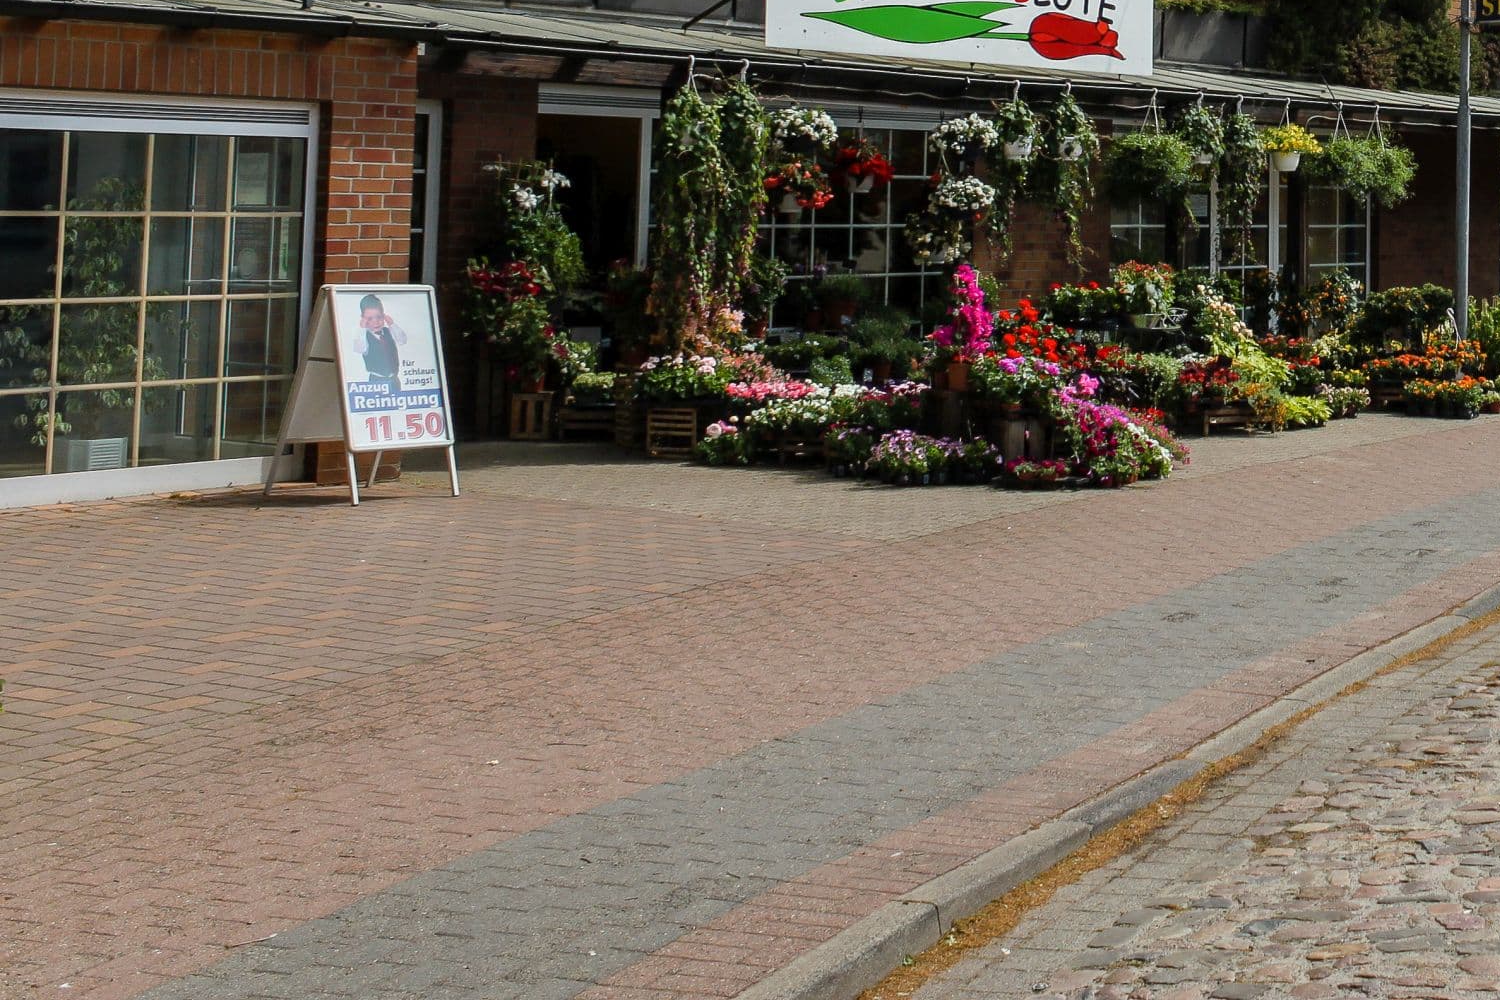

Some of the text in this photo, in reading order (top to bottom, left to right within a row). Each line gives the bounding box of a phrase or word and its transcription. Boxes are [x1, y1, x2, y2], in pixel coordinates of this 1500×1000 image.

[402, 359, 415, 367] für
[403, 368, 435, 376] schlaue
[404, 377, 433, 386] Jungs!
[349, 382, 390, 395] Anzug
[354, 393, 439, 410] Reinigung
[365, 411, 445, 442] 11.50
